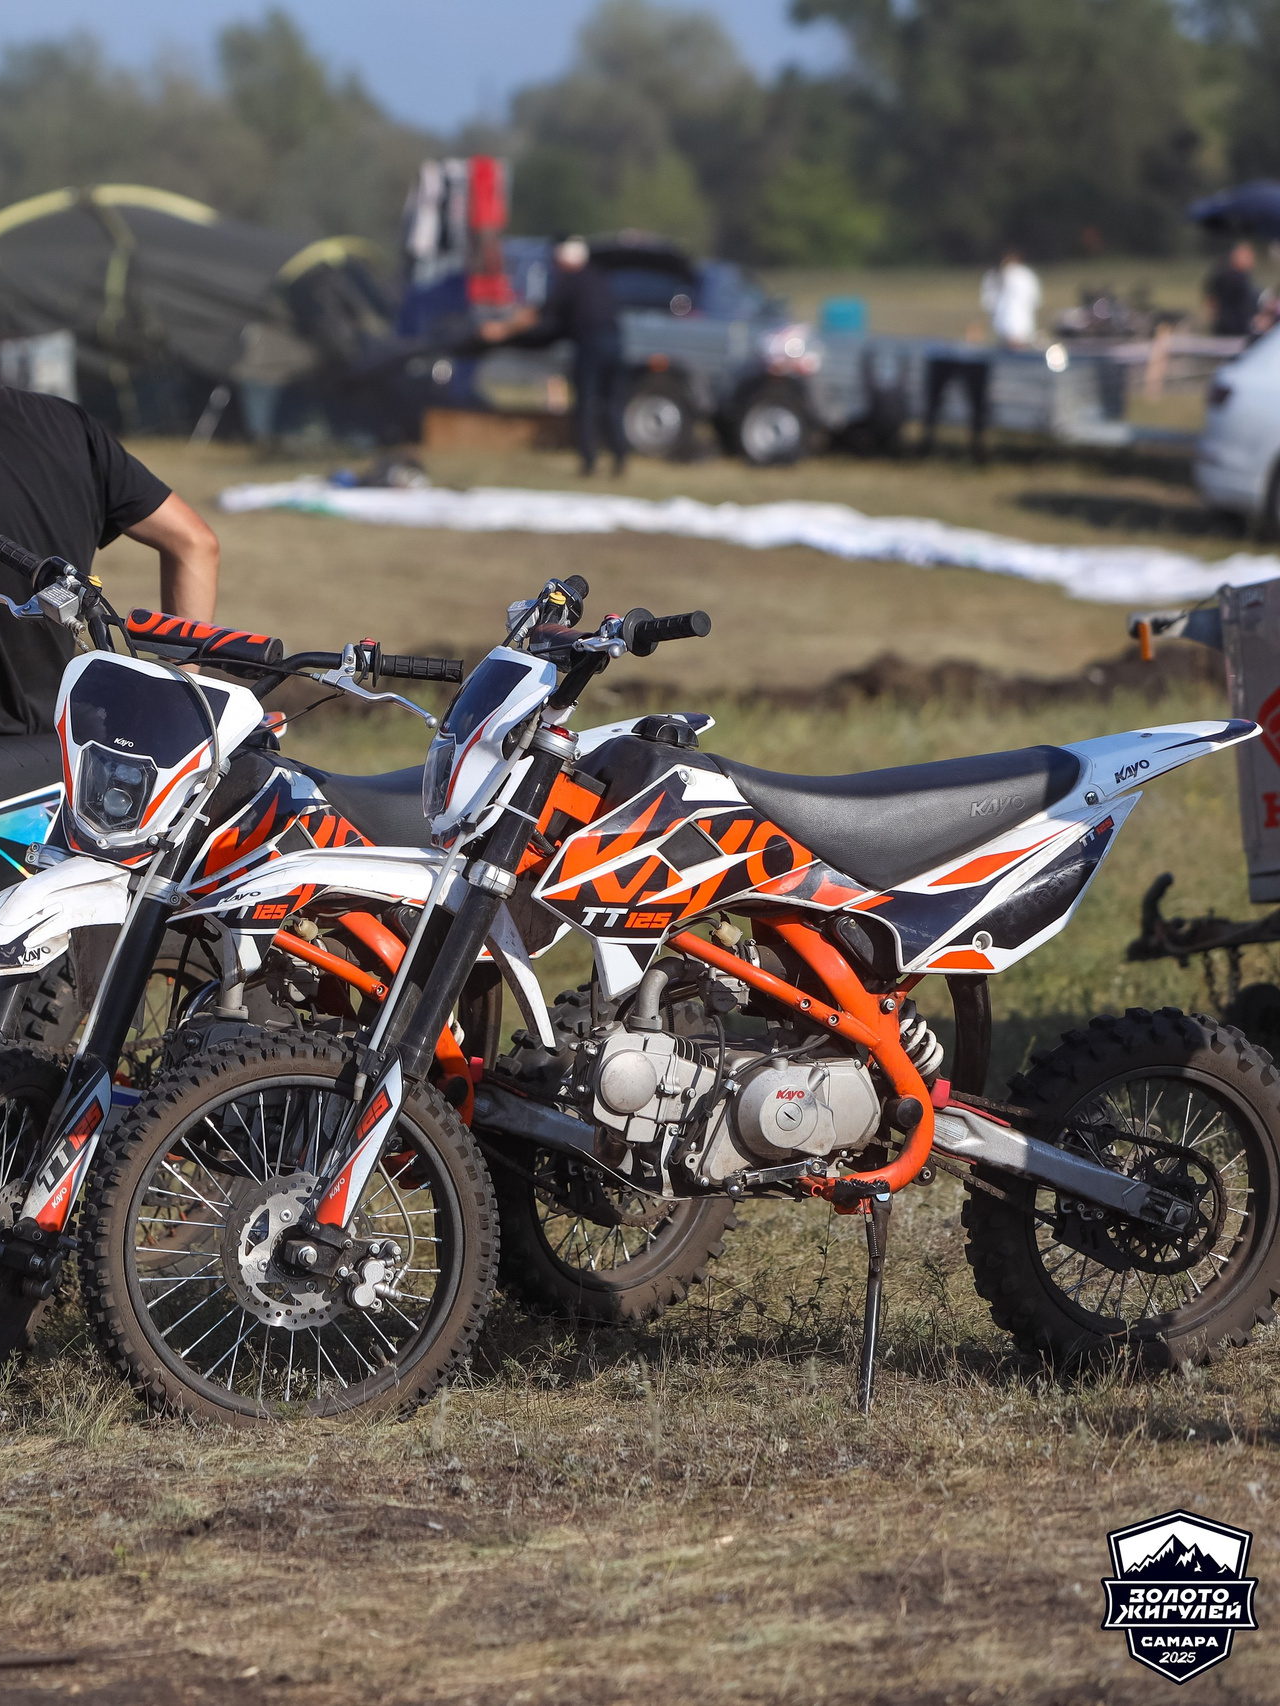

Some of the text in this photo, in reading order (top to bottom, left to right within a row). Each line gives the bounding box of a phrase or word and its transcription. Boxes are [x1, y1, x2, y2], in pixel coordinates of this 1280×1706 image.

[114, 737, 134, 748] KAYO
[1115, 759, 1150, 785] KAYO
[971, 794, 1026, 819] KAYO
[776, 1087, 805, 1101] KAYO
[51, 1186, 68, 1209] KAYO
[329, 1177, 346, 1200] KAYO
